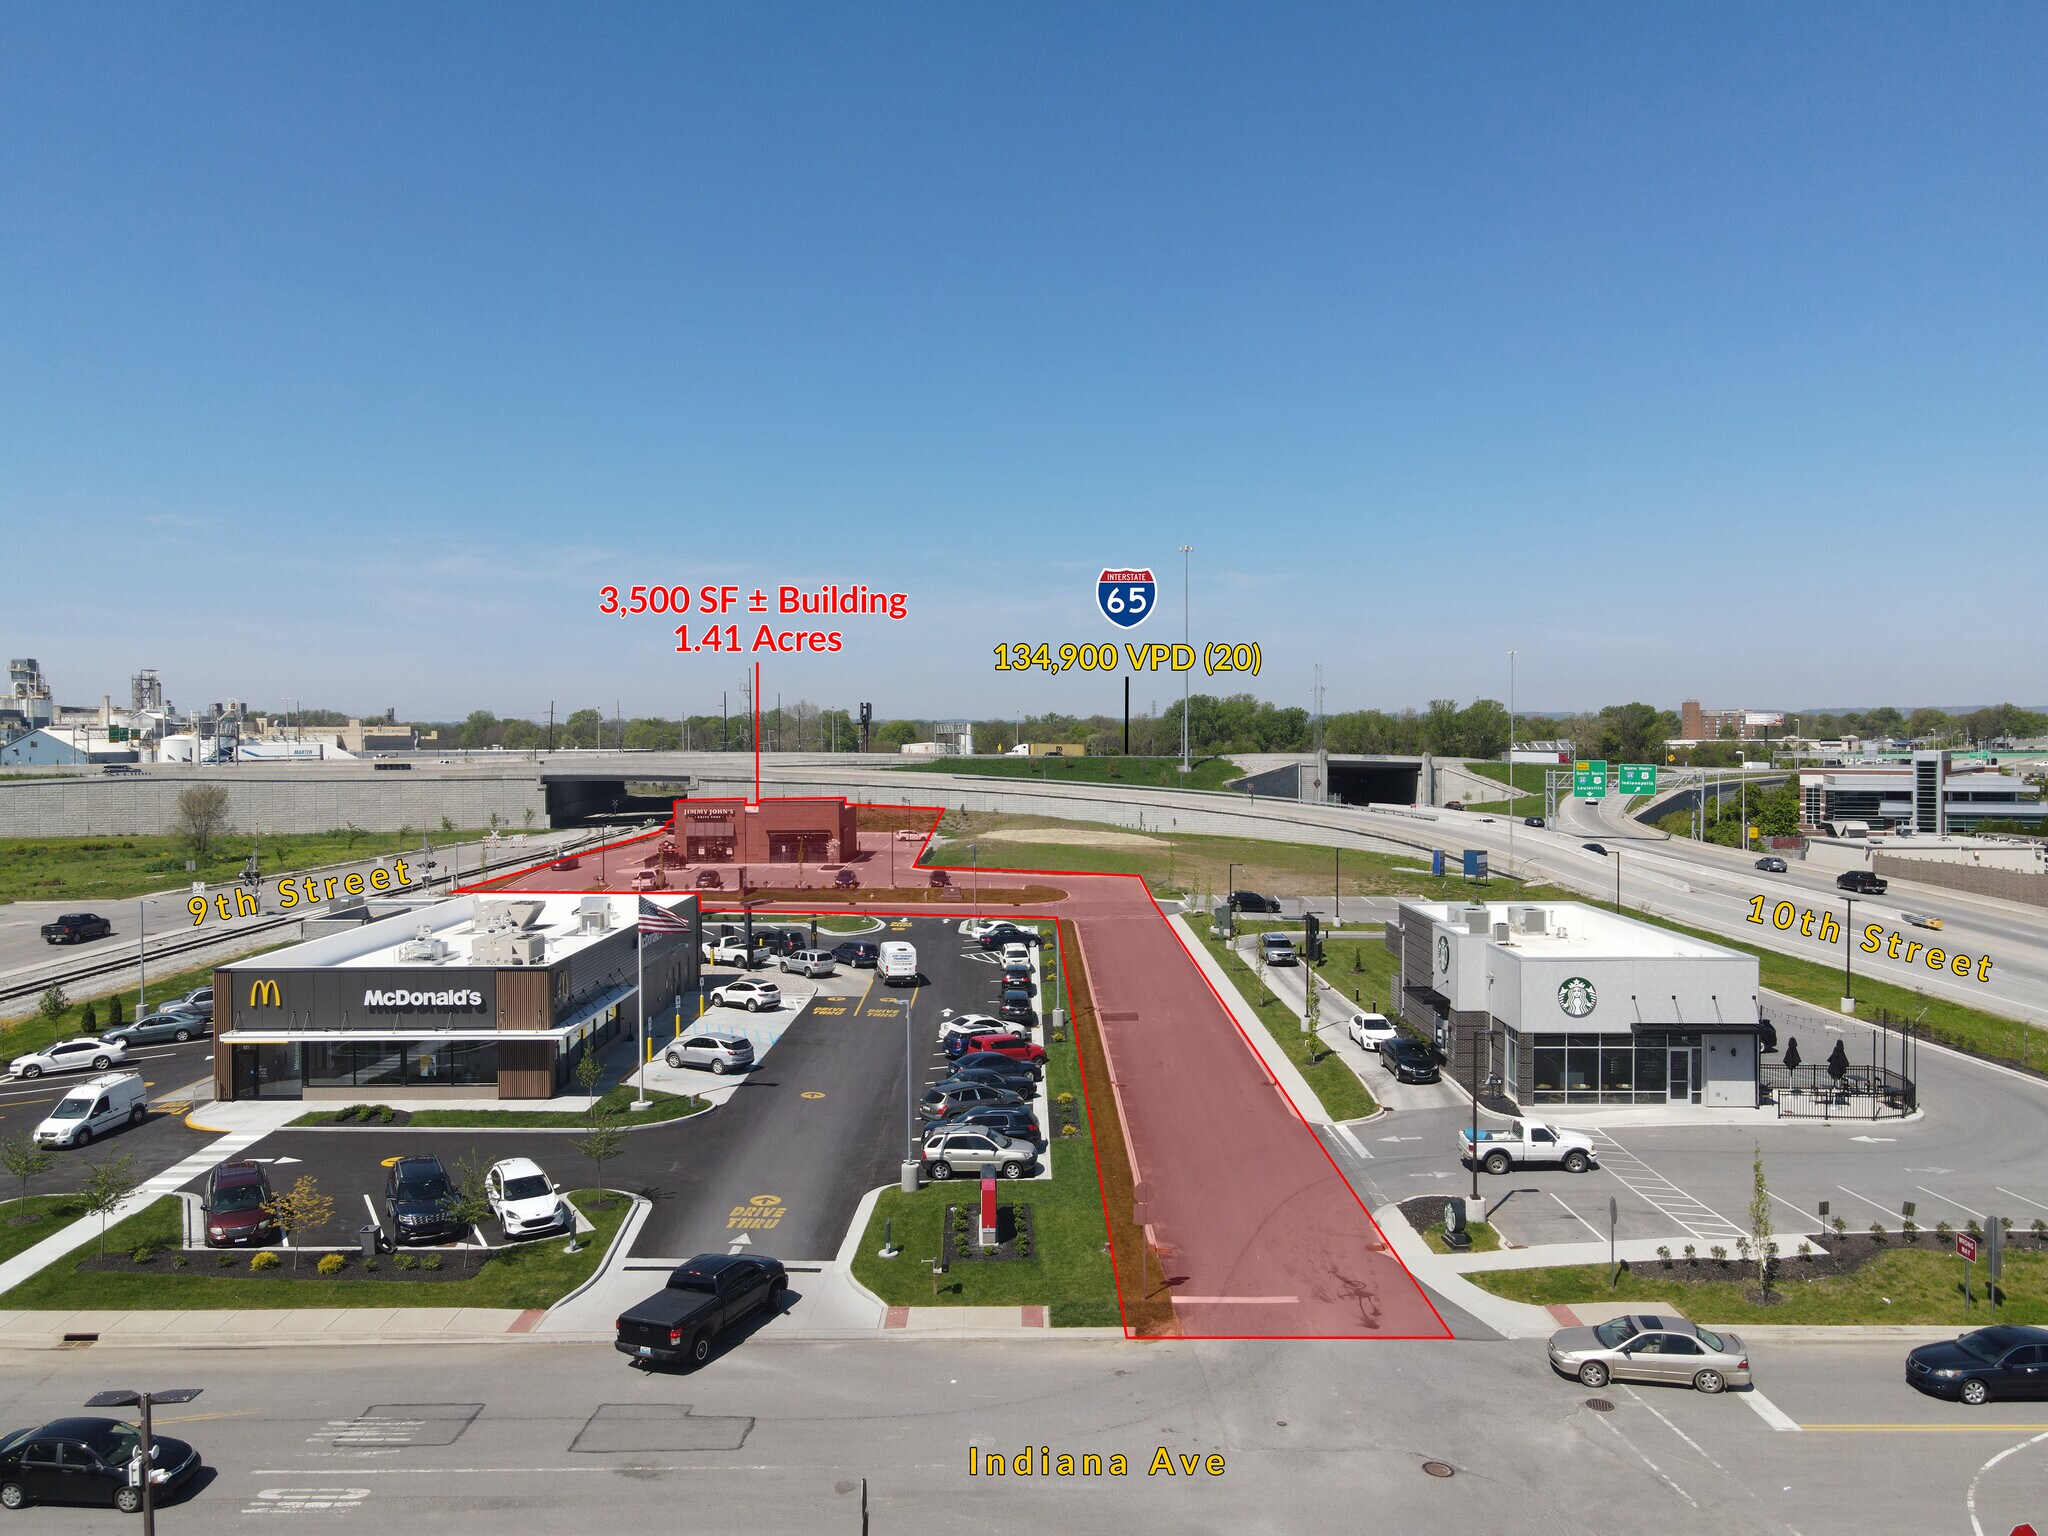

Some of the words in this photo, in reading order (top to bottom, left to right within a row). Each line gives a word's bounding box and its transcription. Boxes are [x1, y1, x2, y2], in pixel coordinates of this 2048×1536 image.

[364, 989, 482, 1006] McDonald's
[729, 1206, 787, 1217] DRIVE
[726, 1218, 780, 1228] THRU
[1959, 1236, 1974, 1249] WRONG
[1961, 1246, 1971, 1255] WAY
